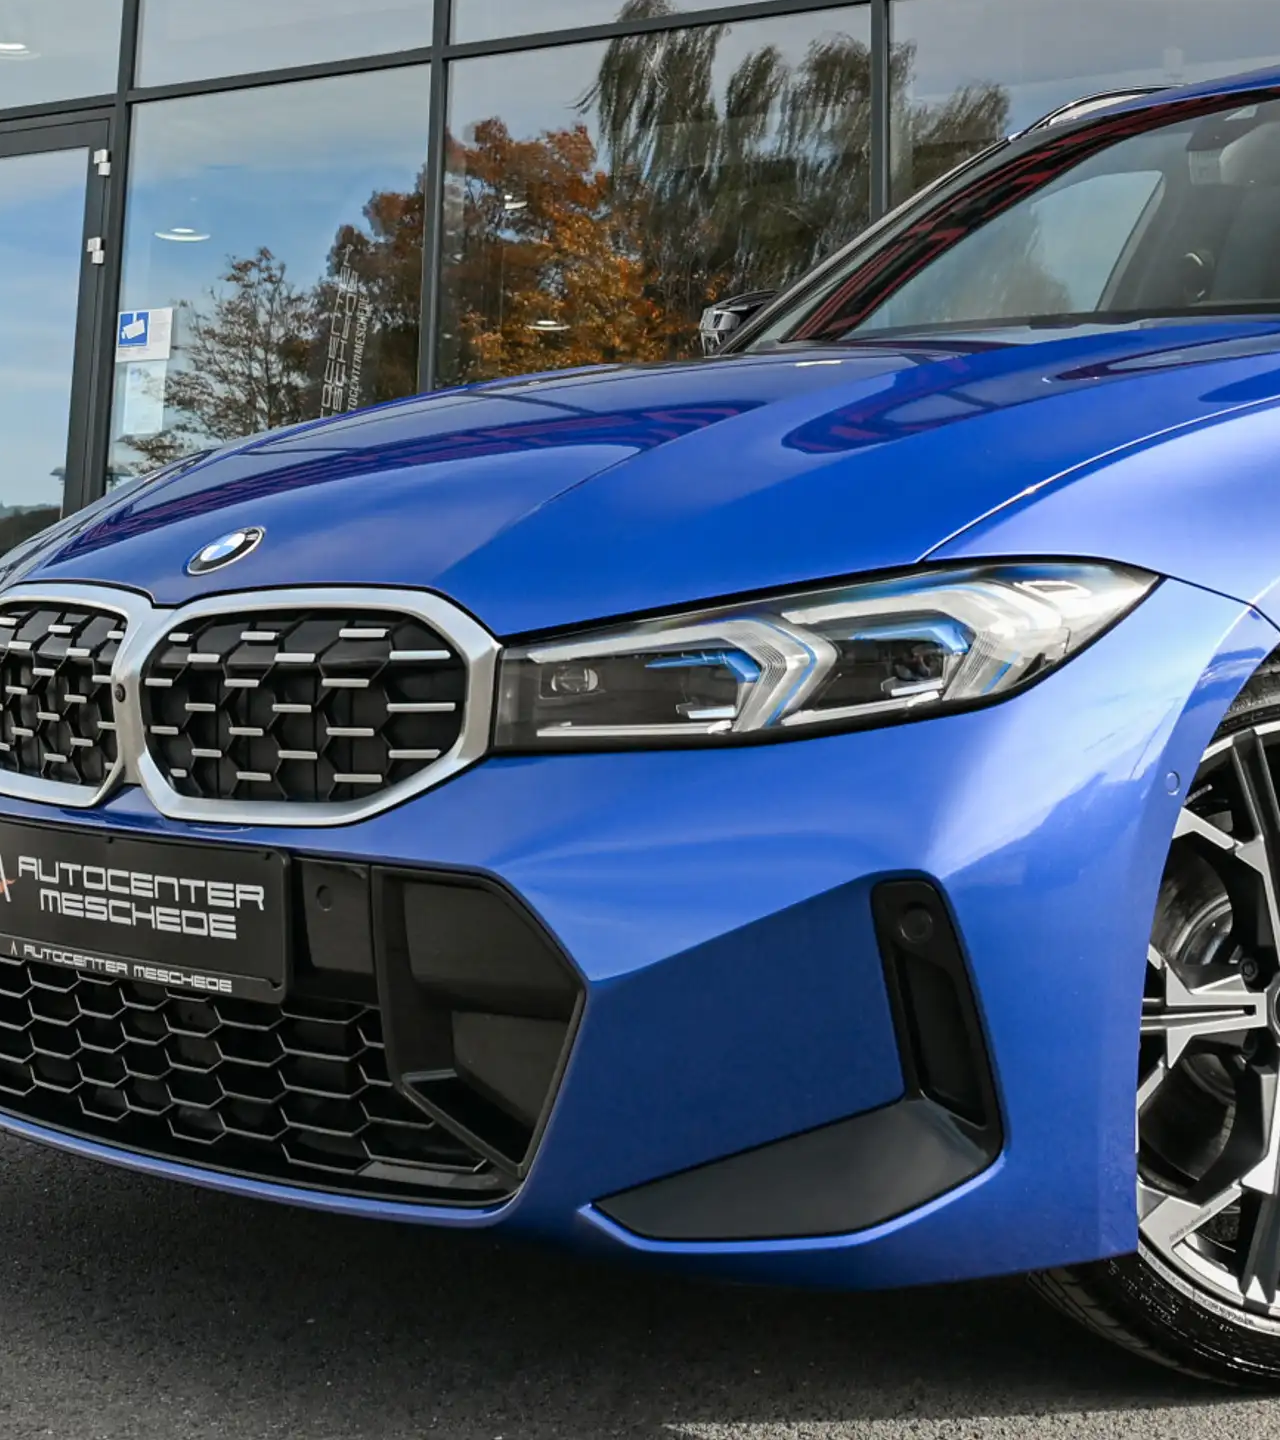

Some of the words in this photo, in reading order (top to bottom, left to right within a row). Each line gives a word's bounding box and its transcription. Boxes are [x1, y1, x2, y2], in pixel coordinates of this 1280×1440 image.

[331, 270, 359, 413] SCHEDE
[18, 855, 265, 911] AUTOCENTER
[39, 888, 237, 940] MESCHEDE
[23, 944, 129, 976] AUTOCENTER
[133, 964, 233, 994] MESCHEDE
